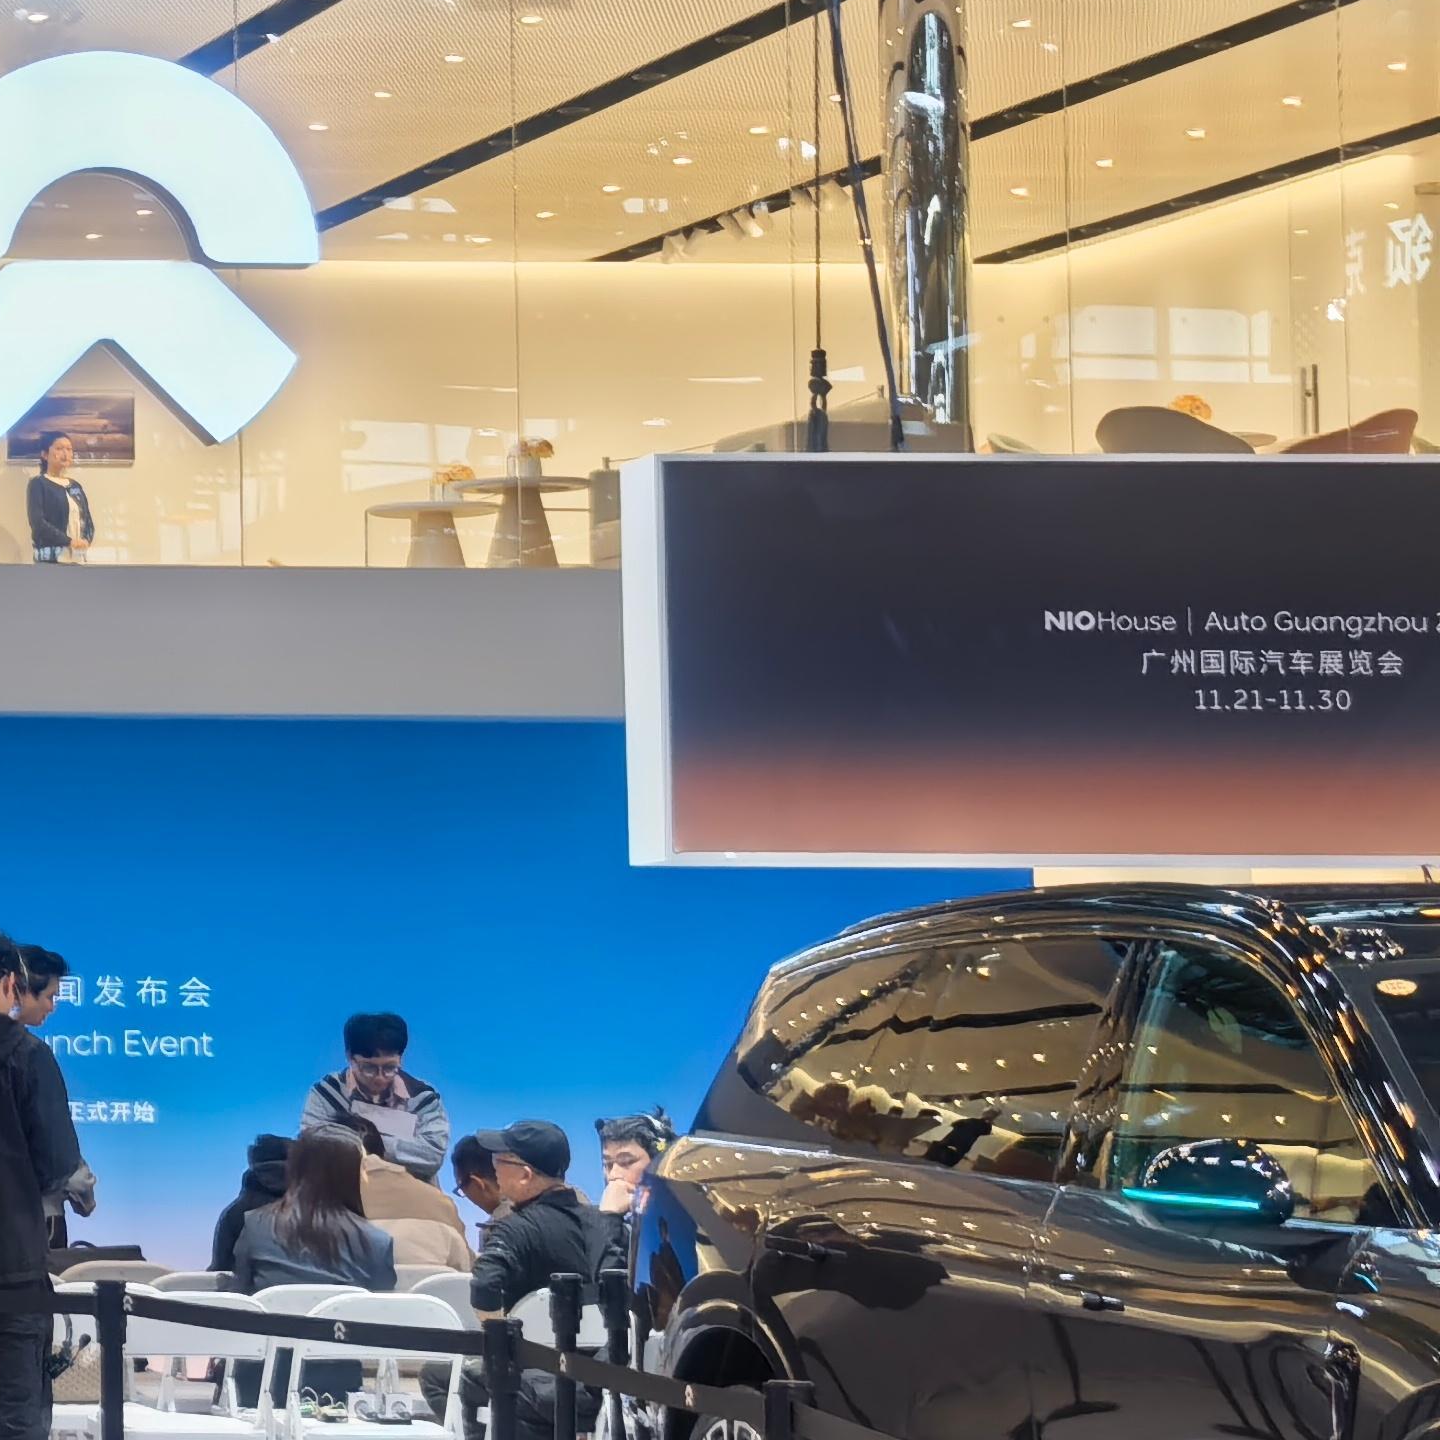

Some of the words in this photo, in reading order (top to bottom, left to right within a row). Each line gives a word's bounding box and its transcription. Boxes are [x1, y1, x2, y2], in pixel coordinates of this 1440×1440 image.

[1044, 610, 1178, 633] NIOHouse
[1204, 611, 1268, 633] Auto
[1274, 610, 1429, 638] Guangzhou
[1140, 648, 1404, 677] 广州国际汽车展览会
[1194, 689, 1352, 712] 11.21-11.30
[124, 1029, 215, 1058] Event
